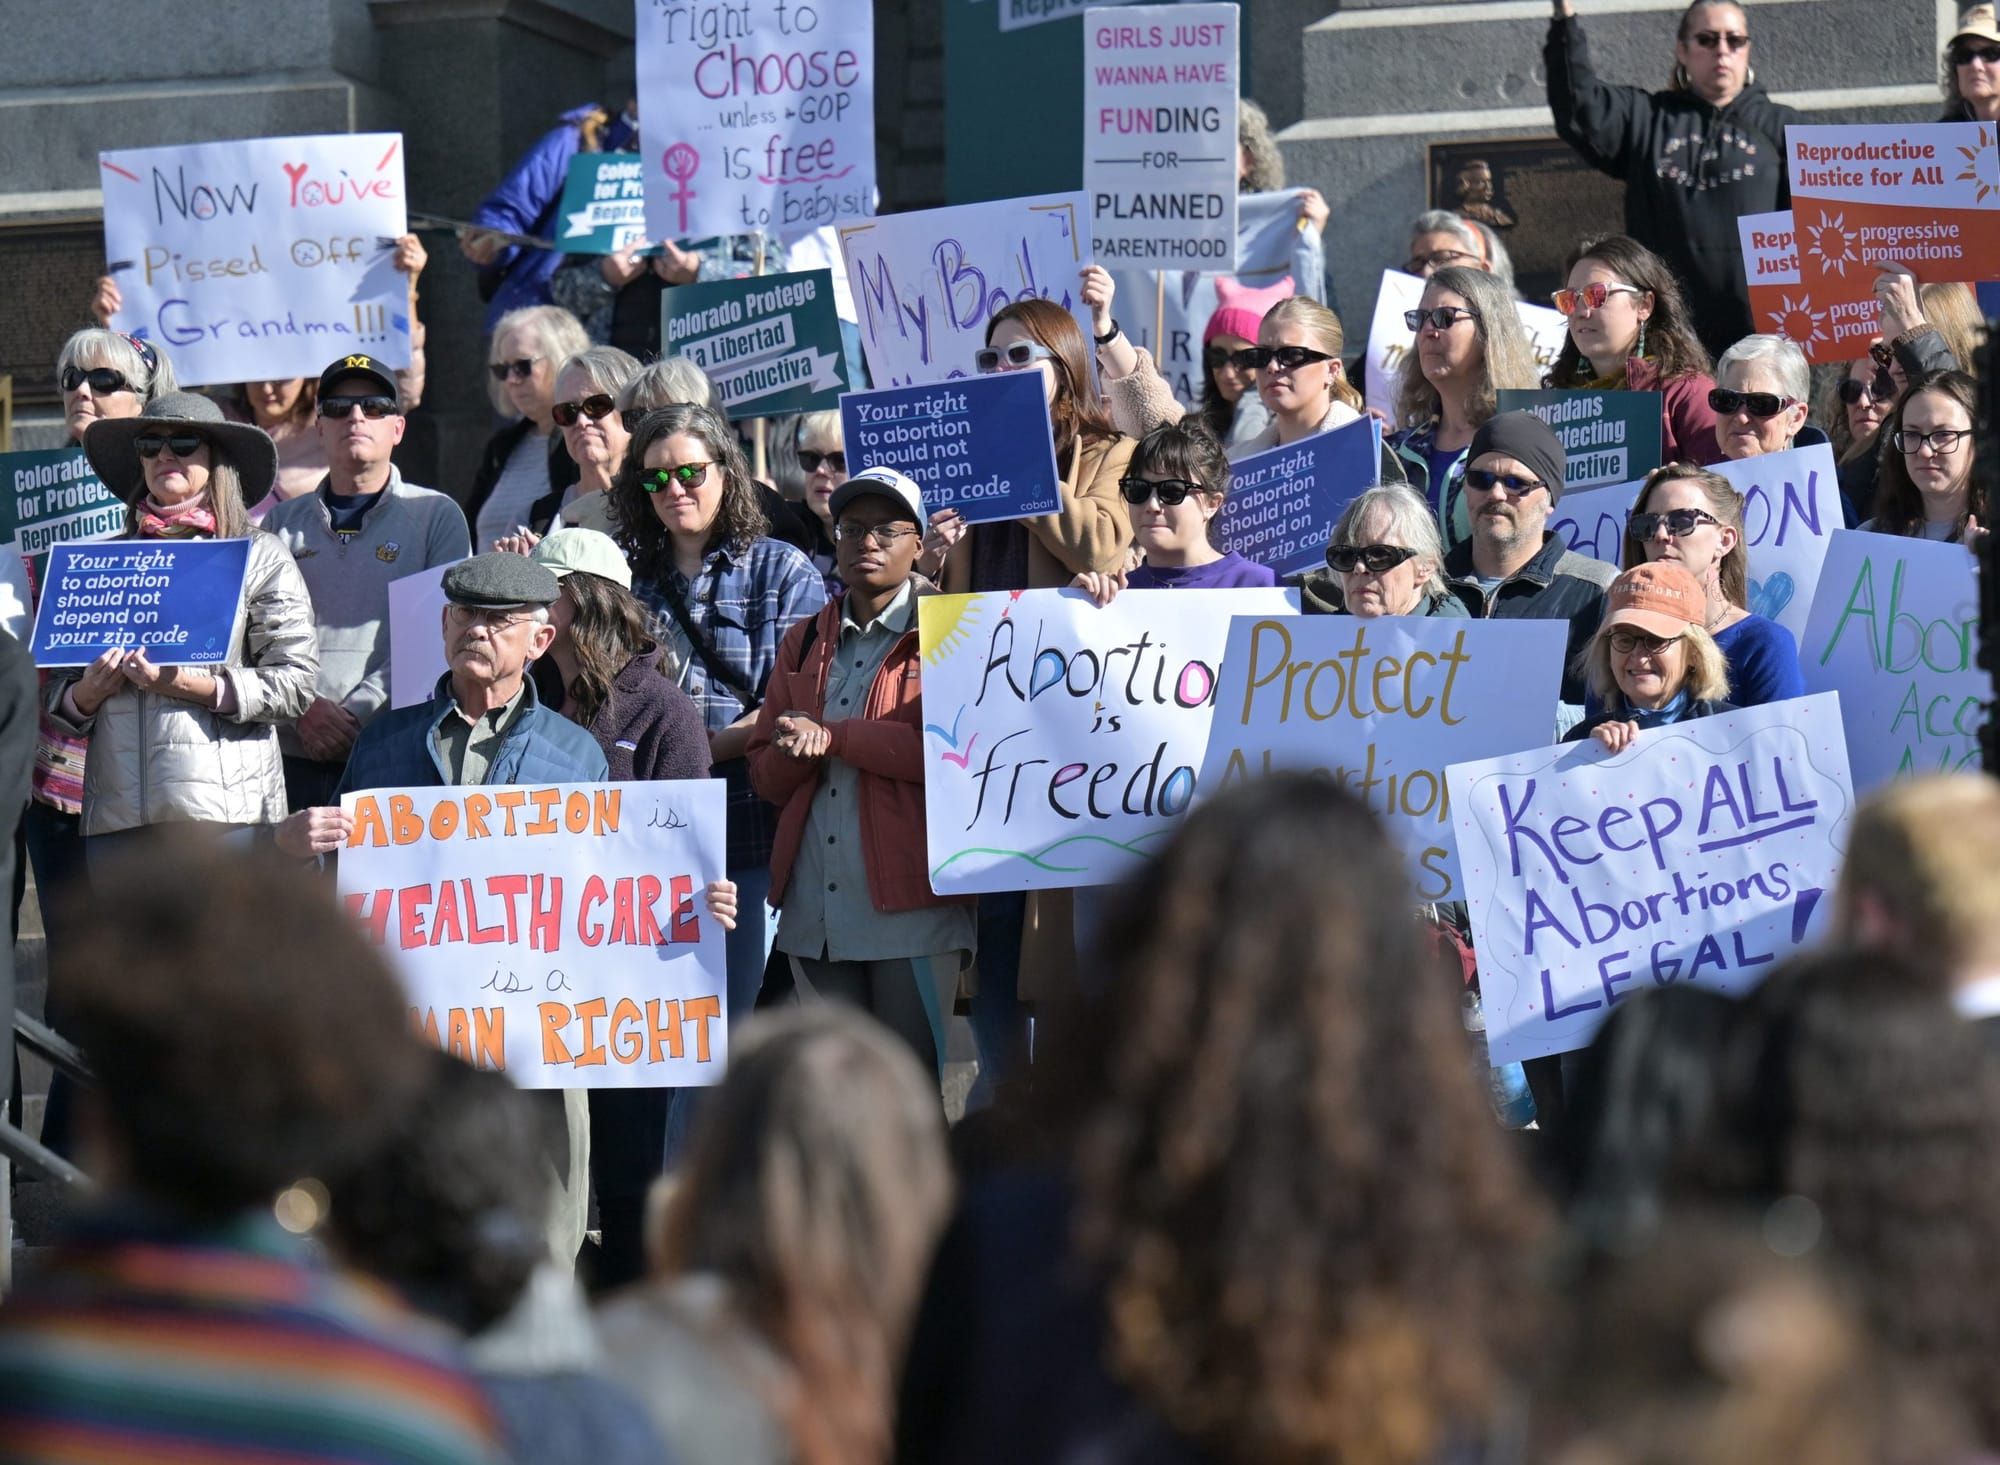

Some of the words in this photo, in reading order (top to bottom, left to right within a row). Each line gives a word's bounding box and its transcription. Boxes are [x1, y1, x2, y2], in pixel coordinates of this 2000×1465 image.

[663, 0, 753, 50] right
[774, 0, 818, 36] to
[1096, 26, 1163, 49] GIRLS
[1169, 25, 1225, 47] JUST
[1096, 65, 1168, 86] WANNA
[1174, 64, 1226, 83] HAVE
[720, 101, 776, 128] unless
[799, 92, 850, 124] GOP
[1099, 107, 1220, 135] FUNDING
[765, 134, 835, 178] free
[1142, 152, 1178, 169] FOR
[1796, 139, 1935, 165] Reproductive
[593, 182, 619, 200] for
[1799, 166, 1864, 187] Justice
[1870, 167, 1903, 186] for
[1911, 166, 1944, 185] All
[740, 194, 770, 225] to
[783, 184, 873, 225] babysit
[1096, 194, 1224, 219] PLANNED
[1860, 220, 1960, 245] progressive
[143, 244, 268, 286] Pissed
[290, 237, 364, 268] Off
[1092, 238, 1227, 258] PARENTHOOD
[1861, 243, 1963, 266] promotions
[1757, 257, 1799, 275] Just
[668, 300, 742, 342] Colorado
[745, 279, 816, 318] Protege
[858, 251, 934, 366] My
[932, 237, 1073, 331] Bod
[711, 321, 786, 364] Libertad
[344, 355, 371, 369] M
[718, 356, 813, 401] roductiva
[856, 402, 908, 423] Your
[914, 392, 968, 419] right
[859, 431, 879, 447] to
[883, 418, 972, 444] abortion
[863, 443, 928, 468] should
[933, 438, 968, 459] not
[1270, 450, 1316, 479] right
[902, 463, 940, 483] end
[945, 461, 972, 479] on
[17, 496, 40, 521] for
[46, 480, 117, 513] Protec
[921, 483, 954, 508] zip
[960, 474, 1011, 499] code
[1020, 499, 1054, 511] cobalt
[1221, 503, 1238, 516] to
[1242, 474, 1315, 510] abortion
[1221, 505, 1279, 536] should
[1282, 493, 1311, 516] not
[1222, 519, 1287, 554] depend
[1290, 514, 1312, 532] on
[1268, 538, 1295, 560] zip
[67, 553, 119, 570] Your
[123, 549, 176, 572] right
[61, 575, 81, 590] to
[85, 572, 170, 589] abortion
[57, 590, 123, 609] should
[127, 590, 161, 607] not
[53, 608, 129, 629] depend
[133, 609, 158, 624] on
[1819, 555, 1979, 675] Abor
[44, 631, 99, 650] your
[102, 626, 136, 649] zip
[141, 624, 189, 645] code
[190, 650, 224, 661] cobalt
[1240, 620, 1473, 726] Protect
[1090, 704, 1121, 734] is
[966, 729, 1198, 832] freedo
[346, 788, 622, 848] ABORTION
[647, 799, 687, 828] is
[1497, 778, 1683, 884] Keep
[1698, 756, 1818, 836] ALL
[344, 873, 563, 953] HEALTH
[577, 874, 701, 947] CARE
[1524, 862, 1791, 955] Abortions
[480, 961, 533, 993] is
[546, 969, 572, 991] a
[409, 1005, 505, 1072] MAN
[538, 994, 721, 1069] RIGHT
